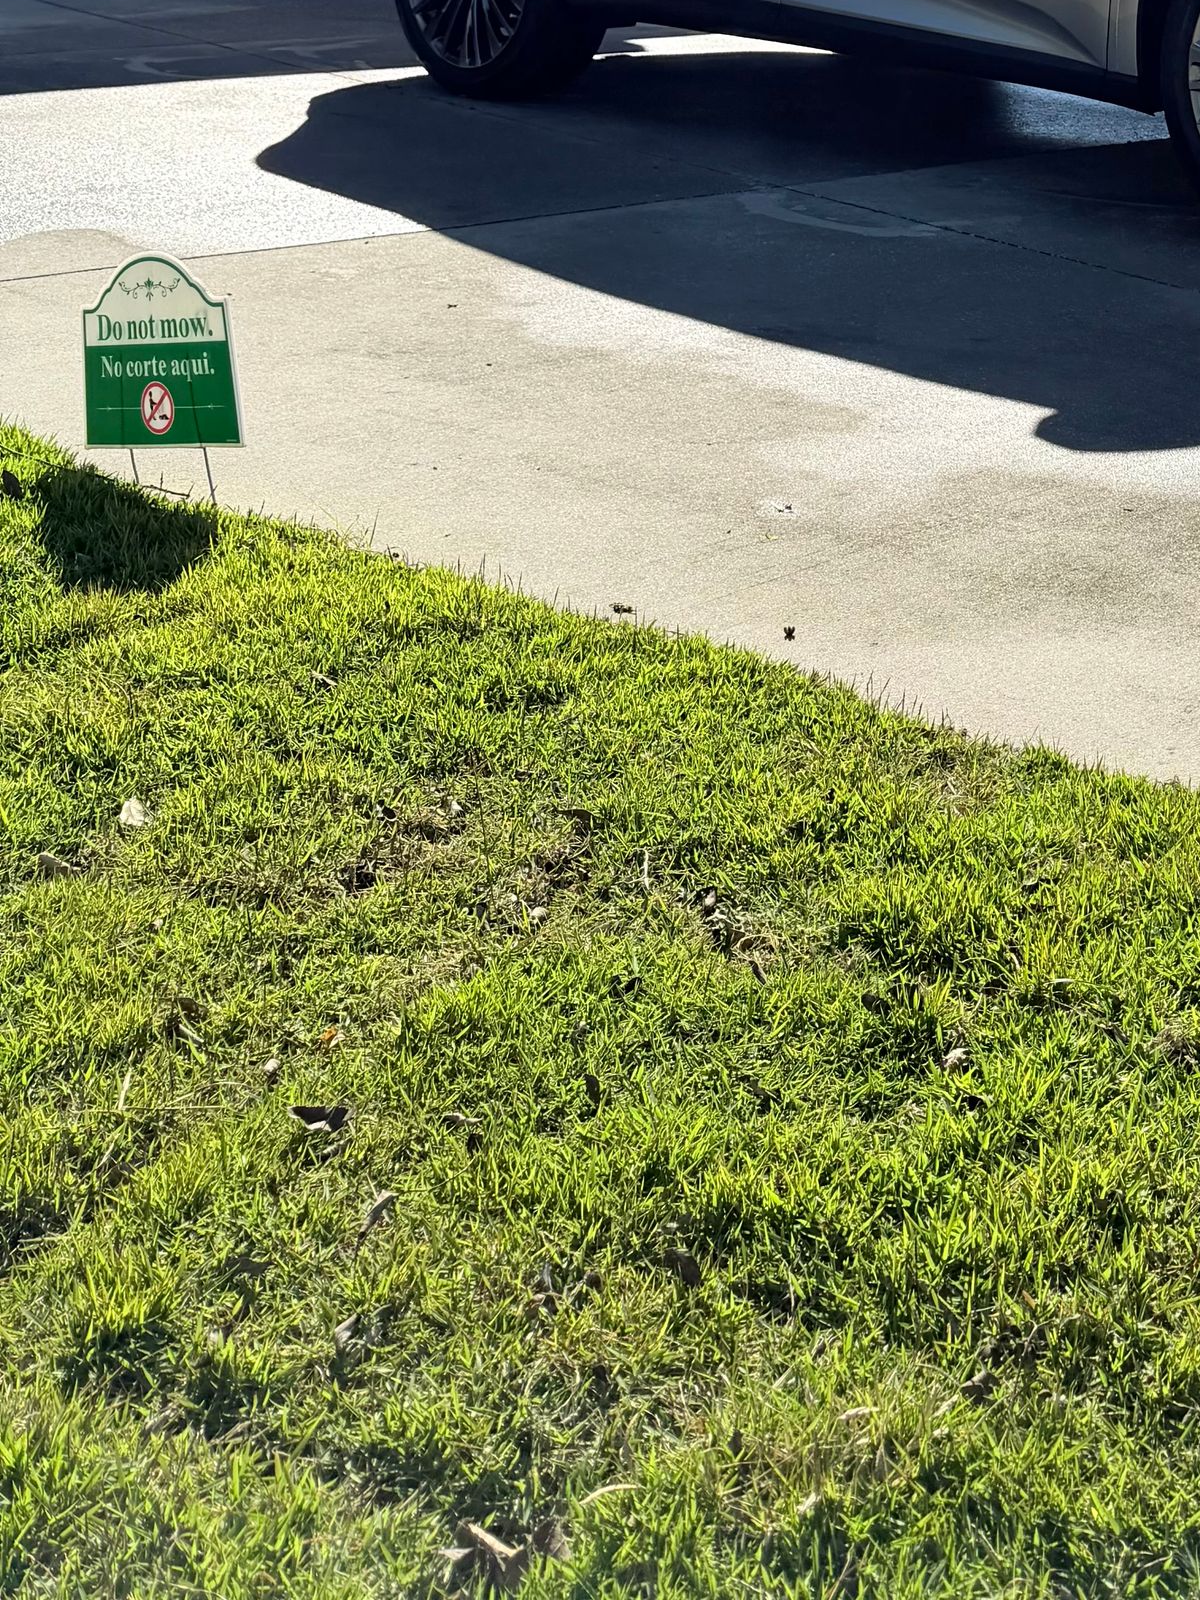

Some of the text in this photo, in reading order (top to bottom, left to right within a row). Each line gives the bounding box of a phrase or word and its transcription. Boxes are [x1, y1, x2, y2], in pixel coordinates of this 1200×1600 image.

[96, 314, 213, 341] Do not mow.
[101, 351, 215, 382] No corte aqui.
